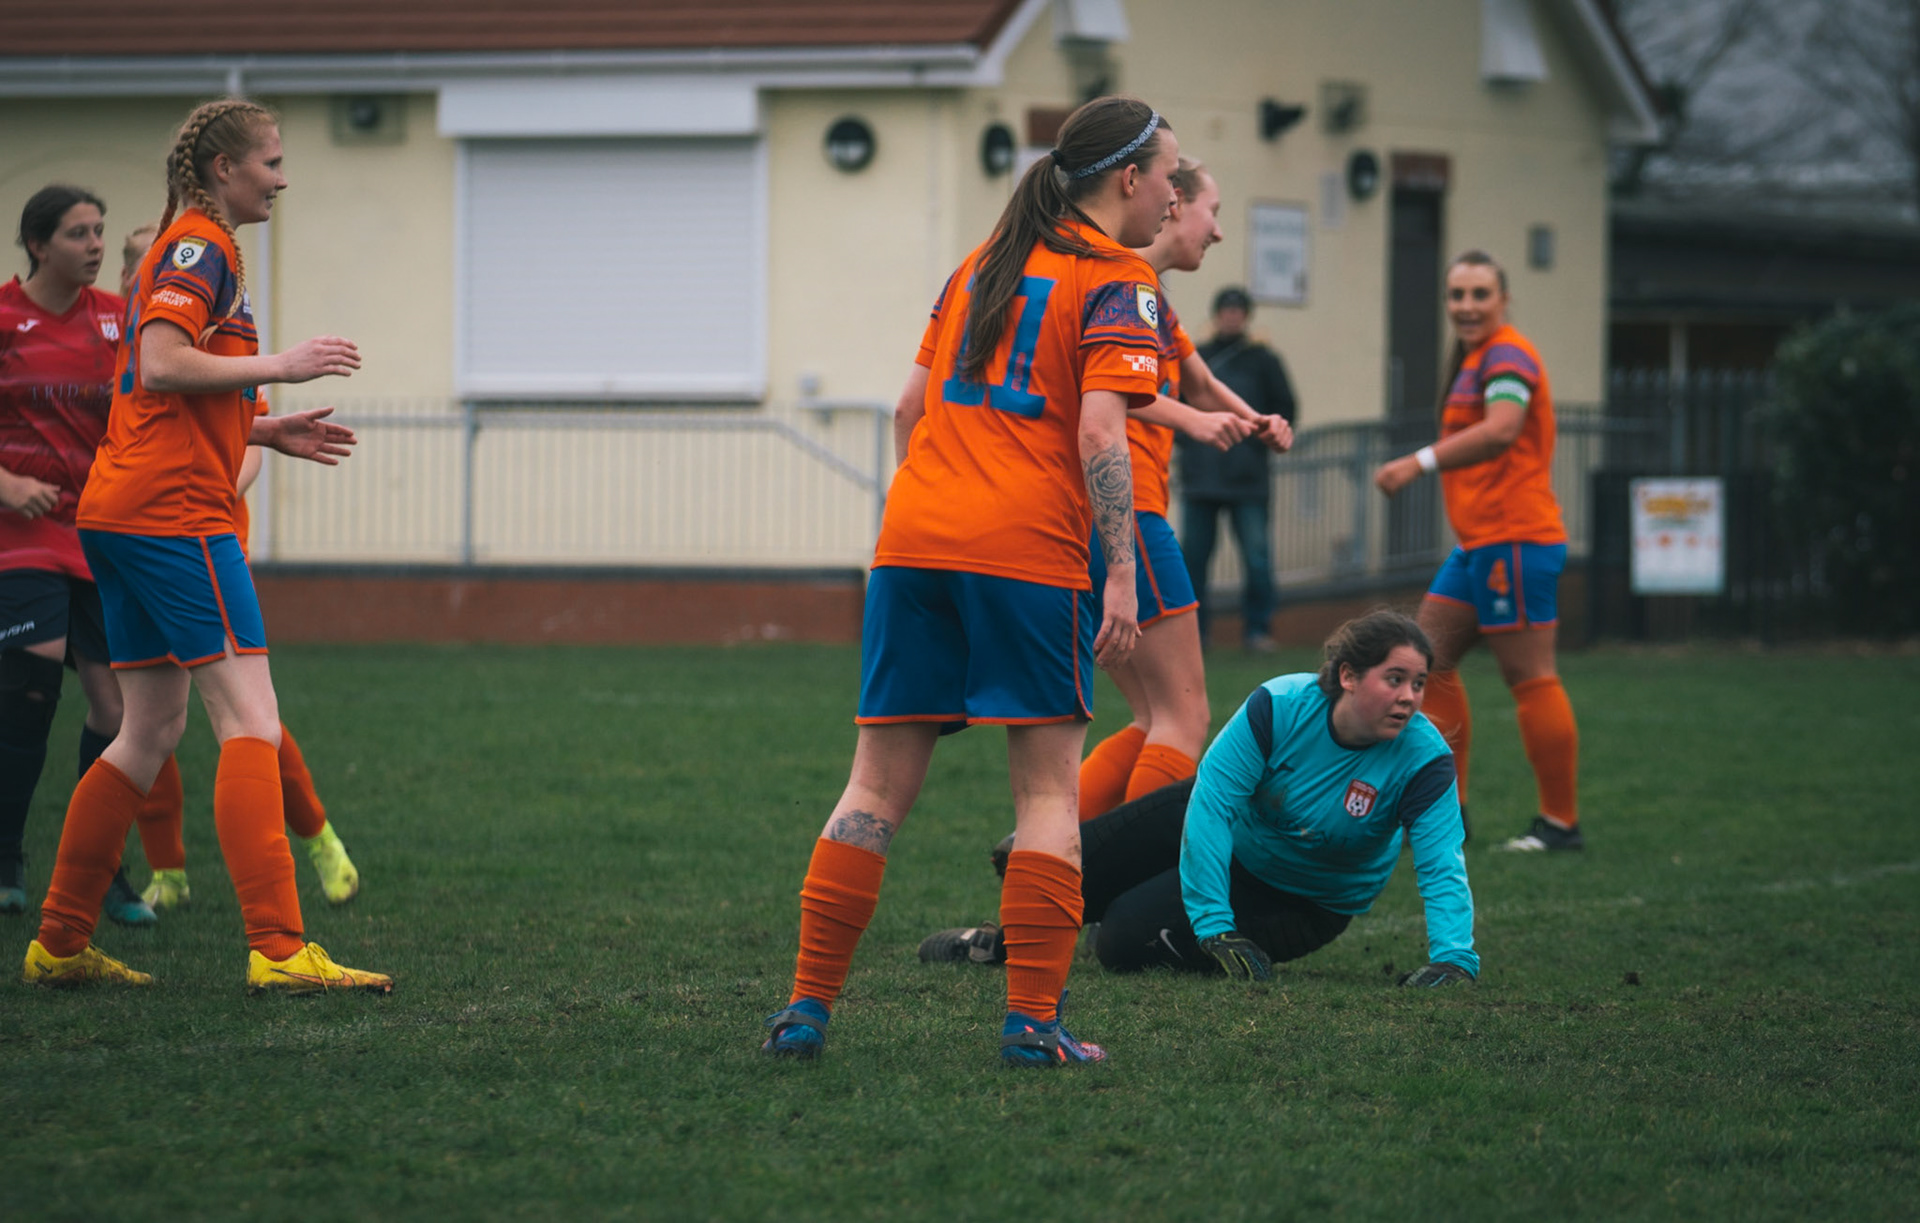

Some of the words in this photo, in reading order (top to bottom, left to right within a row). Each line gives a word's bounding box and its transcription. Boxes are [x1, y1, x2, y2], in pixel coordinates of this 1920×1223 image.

[159, 294, 185, 308] TRUST
[160, 290, 193, 305] OFFSIDE
[1486, 558, 1510, 596] 4
